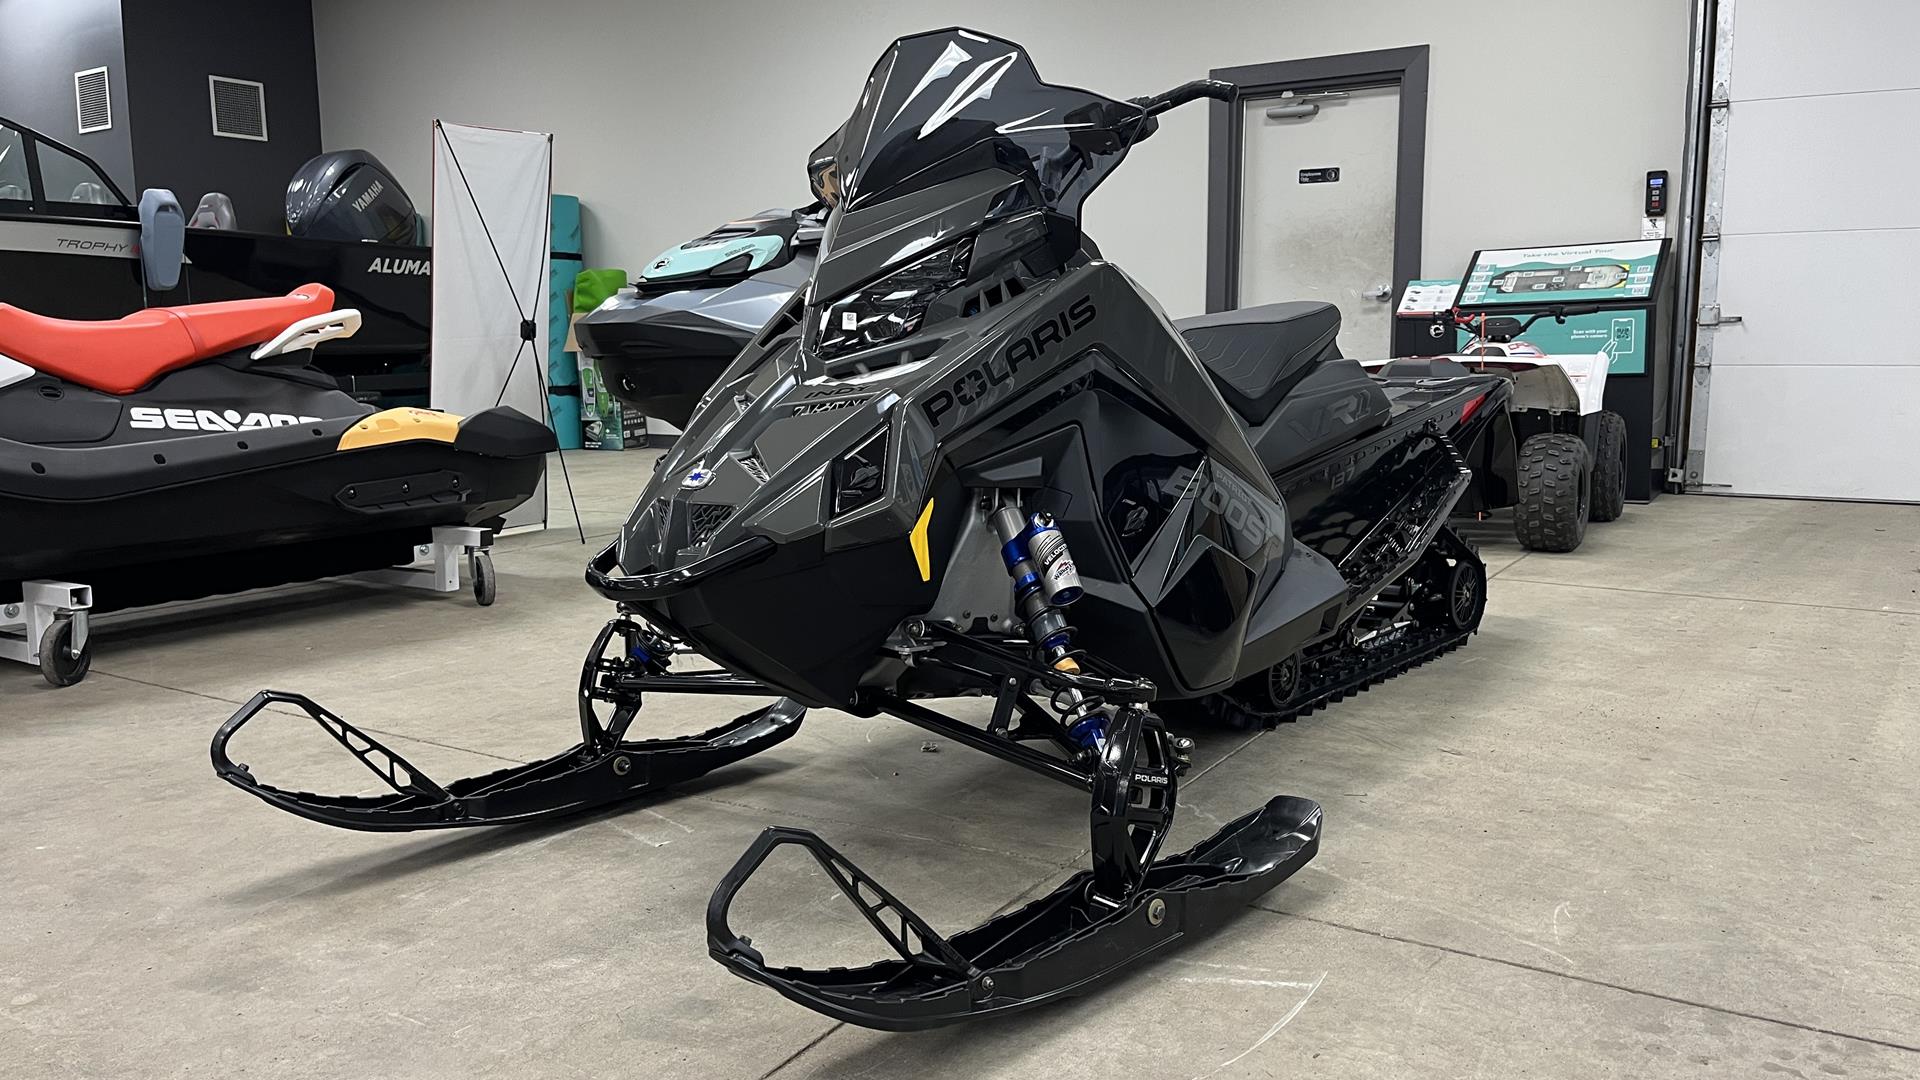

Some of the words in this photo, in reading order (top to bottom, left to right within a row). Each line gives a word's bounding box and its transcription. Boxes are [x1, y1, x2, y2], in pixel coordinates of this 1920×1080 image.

[352, 180, 384, 212] YAMAHA
[57, 238, 128, 252] TROPHY
[367, 257, 431, 276] ALUMA
[920, 294, 1098, 428] POLARIS
[804, 384, 871, 399] INDY
[1287, 389, 1371, 442] VR1
[1216, 469, 1251, 505] PATRIOT
[1331, 466, 1355, 490] 137
[1134, 773, 1168, 785] POLARIS
